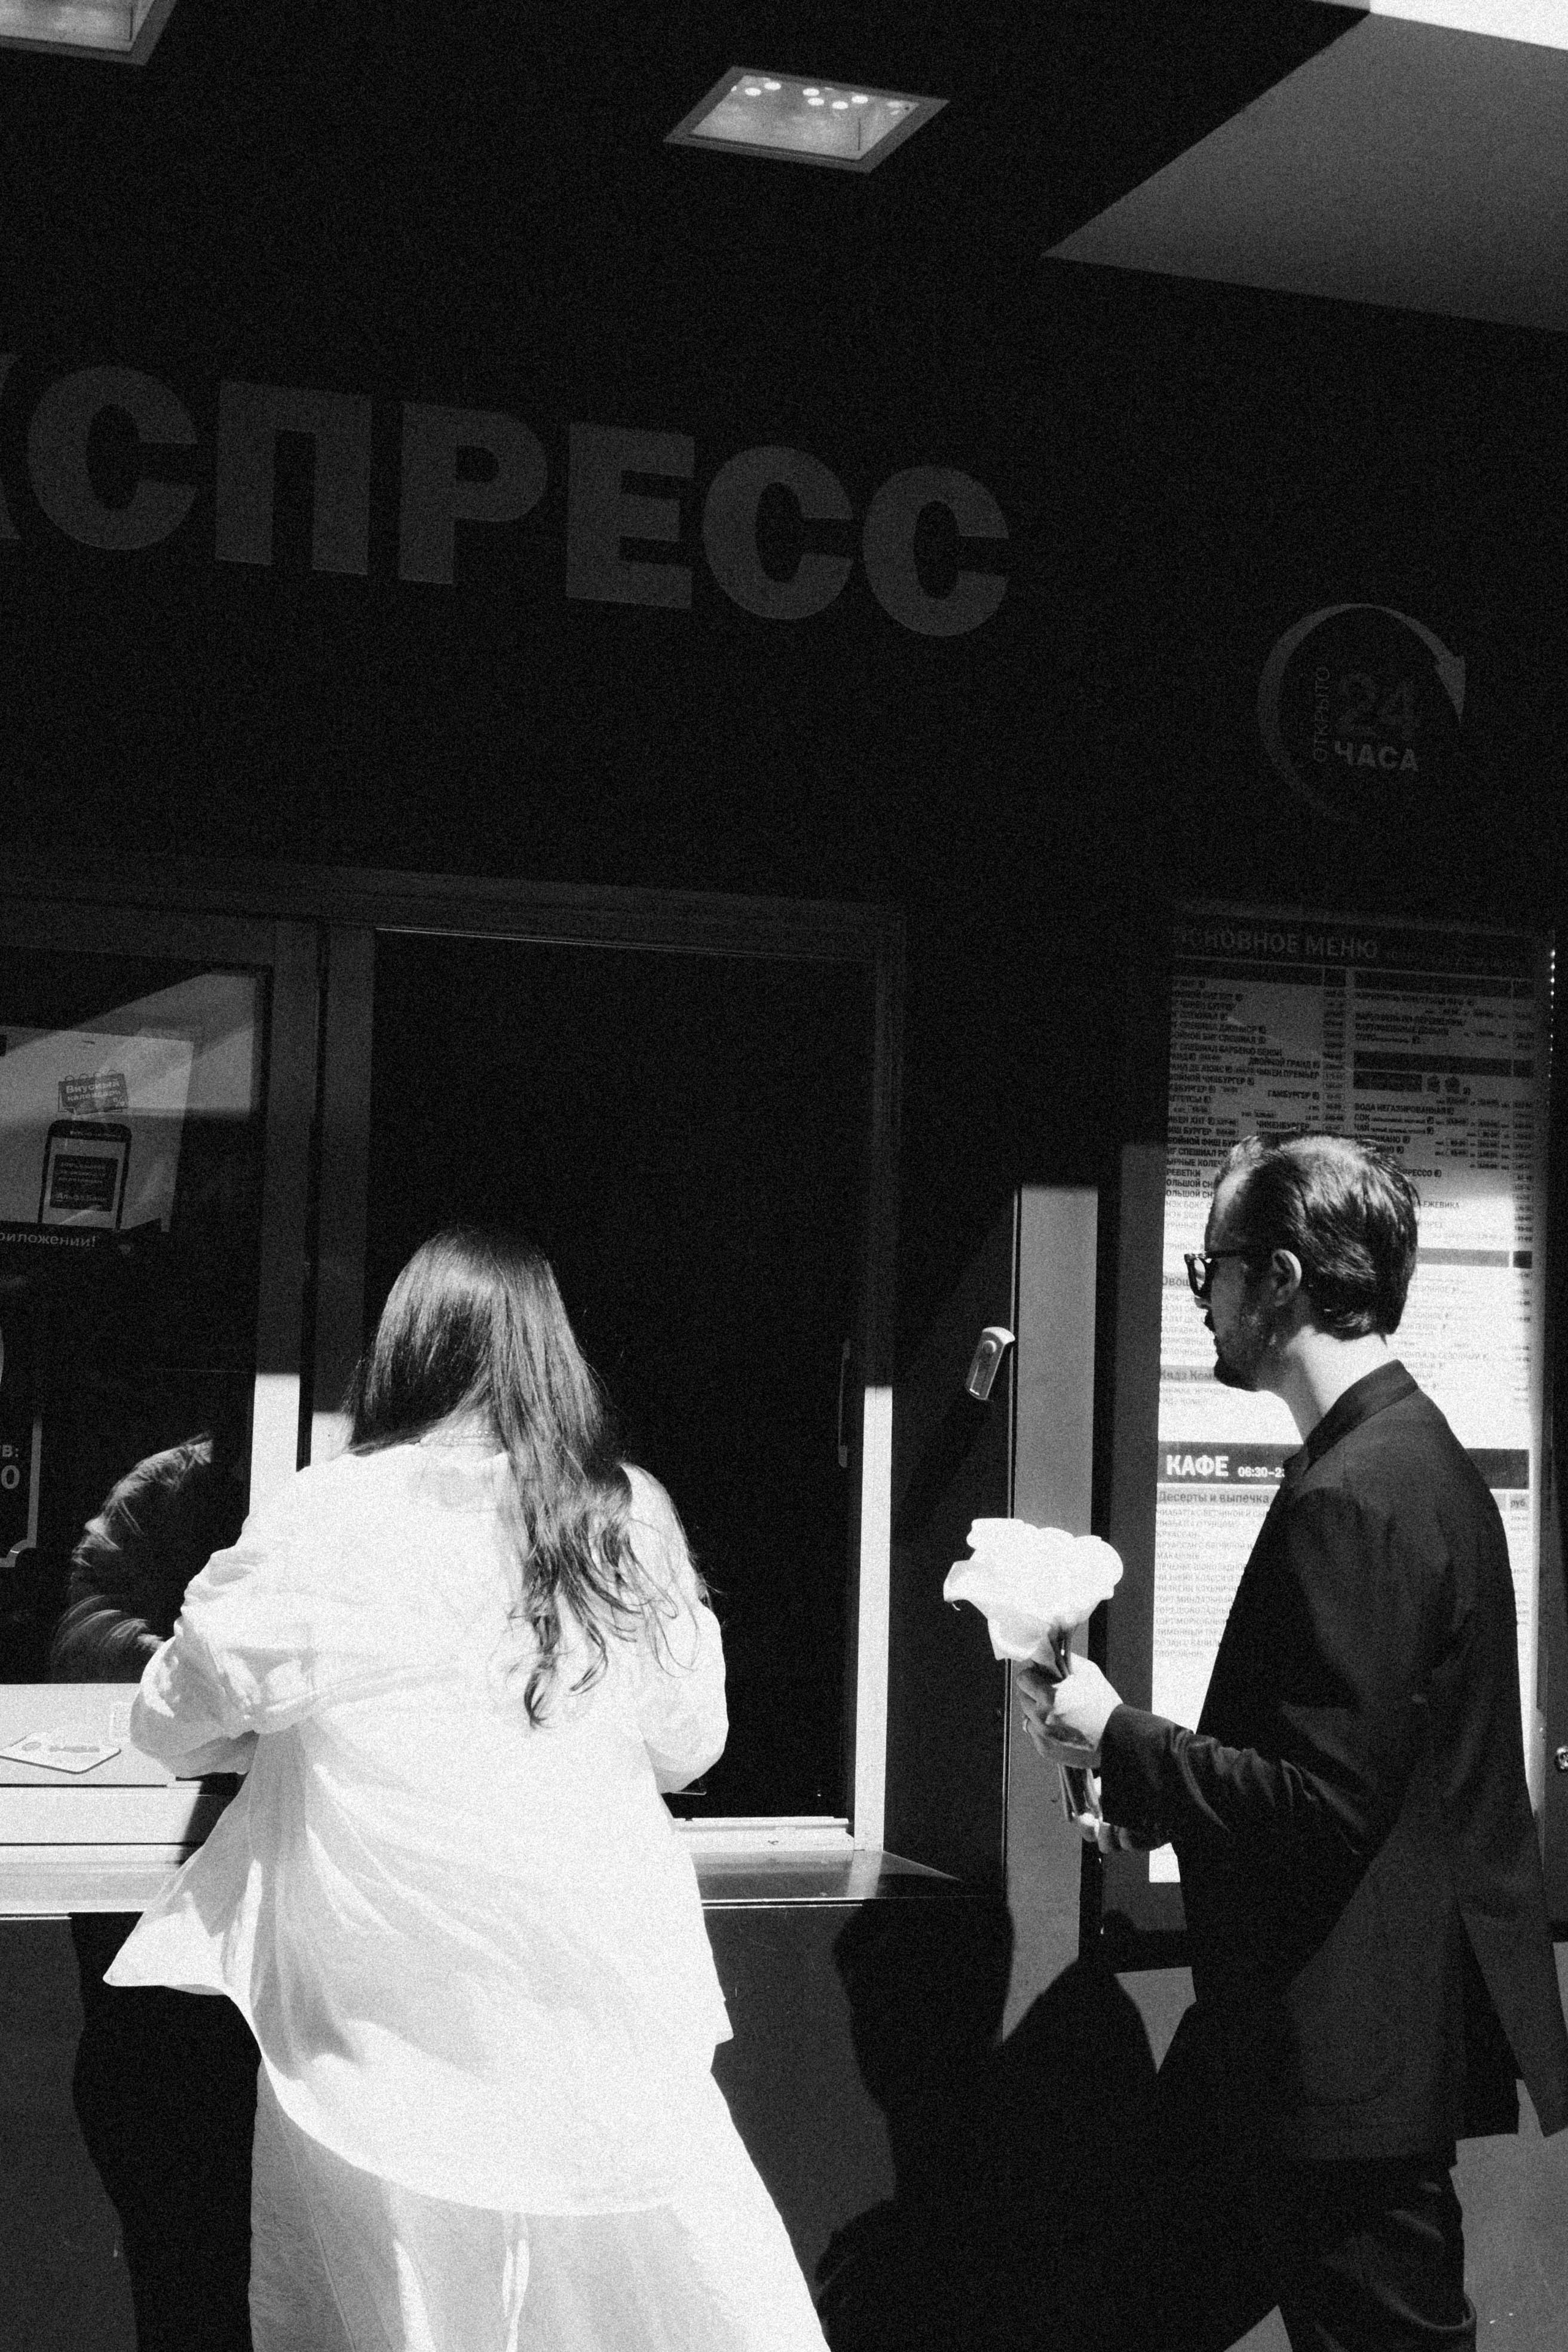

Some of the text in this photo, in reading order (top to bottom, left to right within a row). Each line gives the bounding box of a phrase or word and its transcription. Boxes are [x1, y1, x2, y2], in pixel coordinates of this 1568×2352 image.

[0, 352, 1011, 638] СПРЕСС
[1312, 666, 1331, 763] ОТКРЫТО
[1336, 672, 1420, 742] 24
[1333, 741, 1419, 772] ЧАСА
[1305, 936, 1378, 960] МЕНЮ
[1166, 1454, 1229, 1477] КАФЕ
[1158, 1490, 1207, 1504] Десерты
[1219, 1494, 1270, 1504] выпечка
